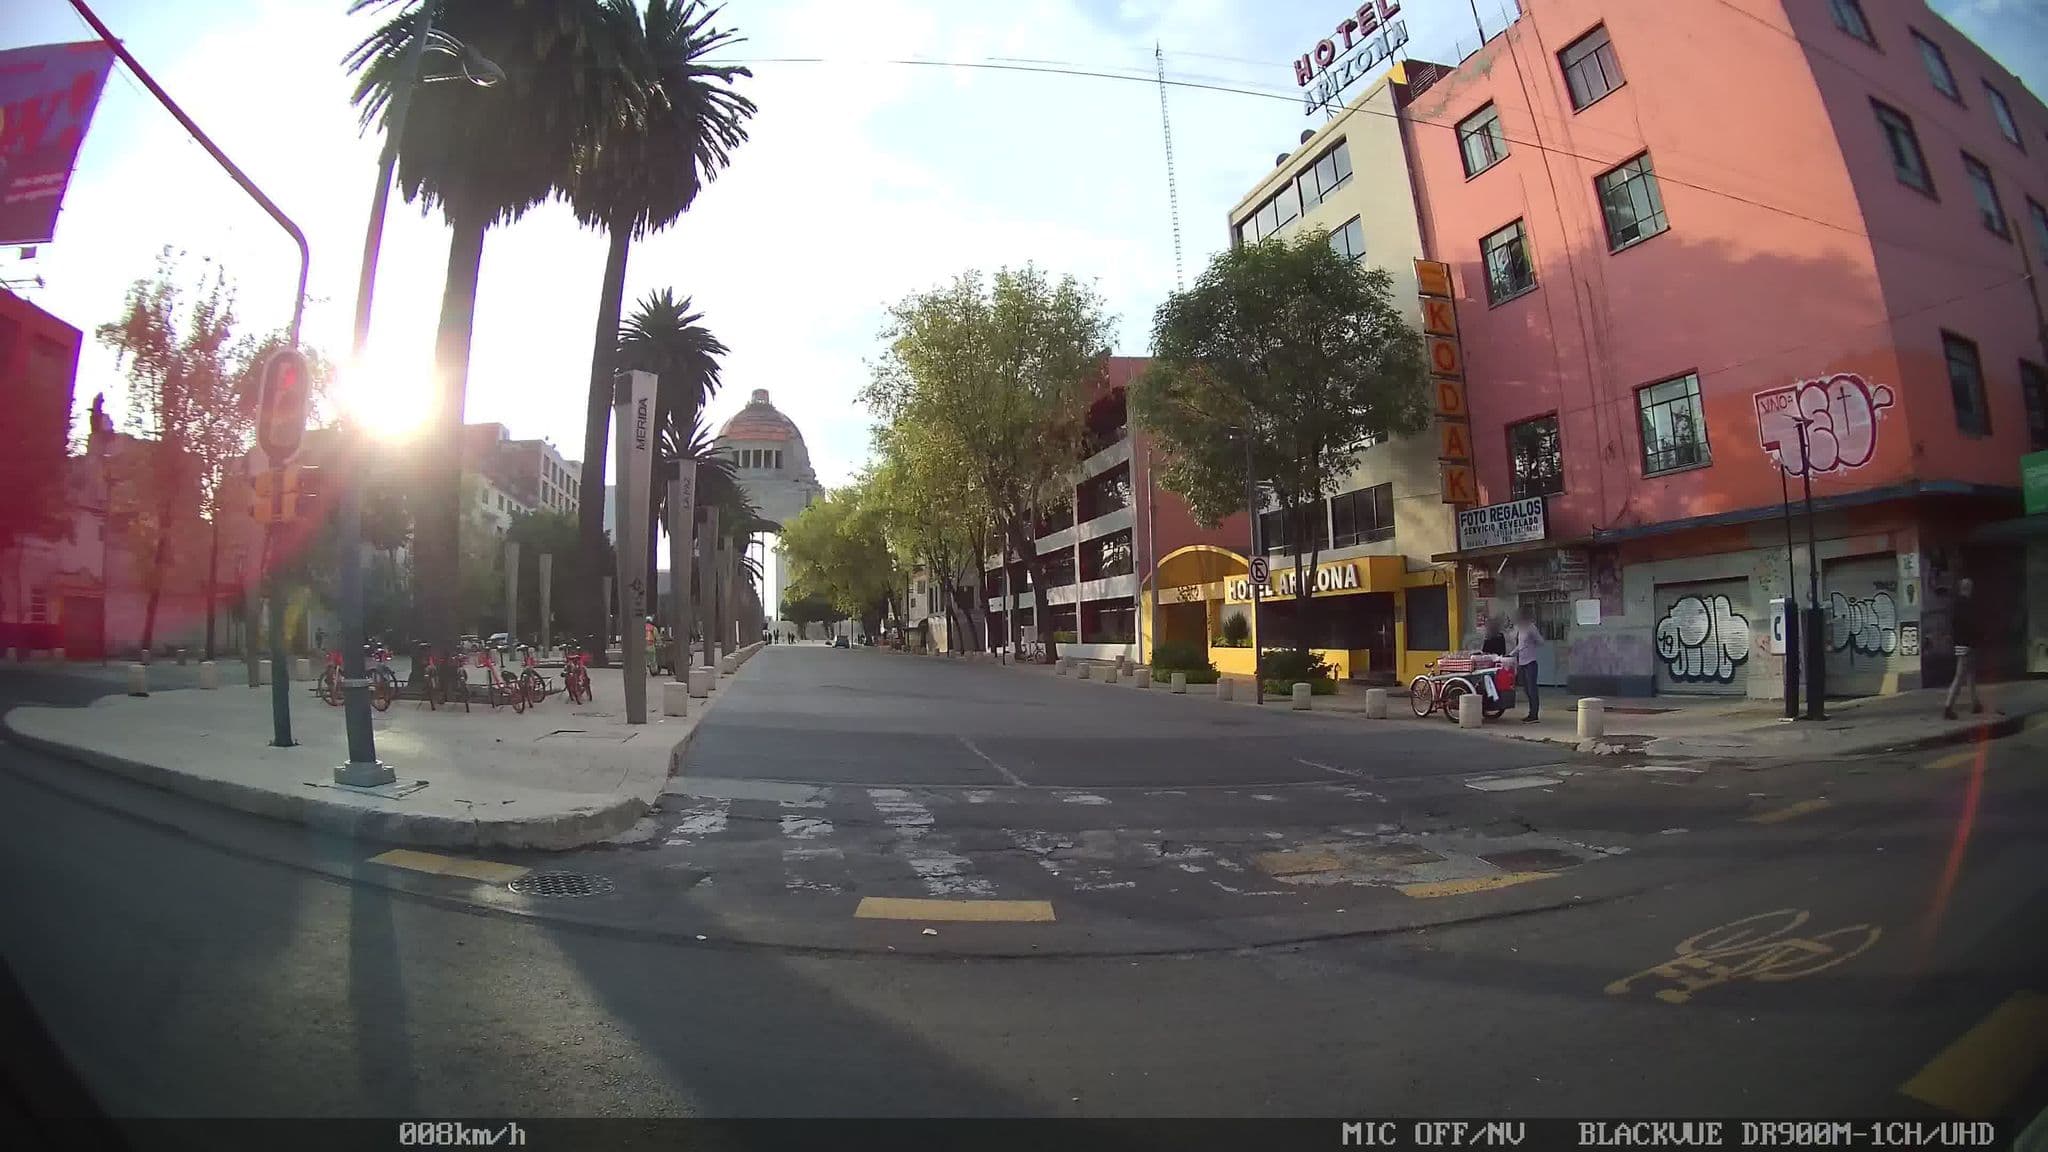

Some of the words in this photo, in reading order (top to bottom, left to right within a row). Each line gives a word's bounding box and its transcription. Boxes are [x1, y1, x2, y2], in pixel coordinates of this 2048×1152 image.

[1294, 0, 1401, 87] HOTEL
[1304, 19, 1409, 116] ARIZONA
[635, 397, 649, 450] MERIDA
[1430, 302, 1467, 498] KODAK
[1460, 509, 1486, 528] FOTO
[1490, 500, 1542, 523] REGALOS
[1463, 523, 1496, 536] SERVICIO
[1499, 516, 1539, 530] REVELADO
